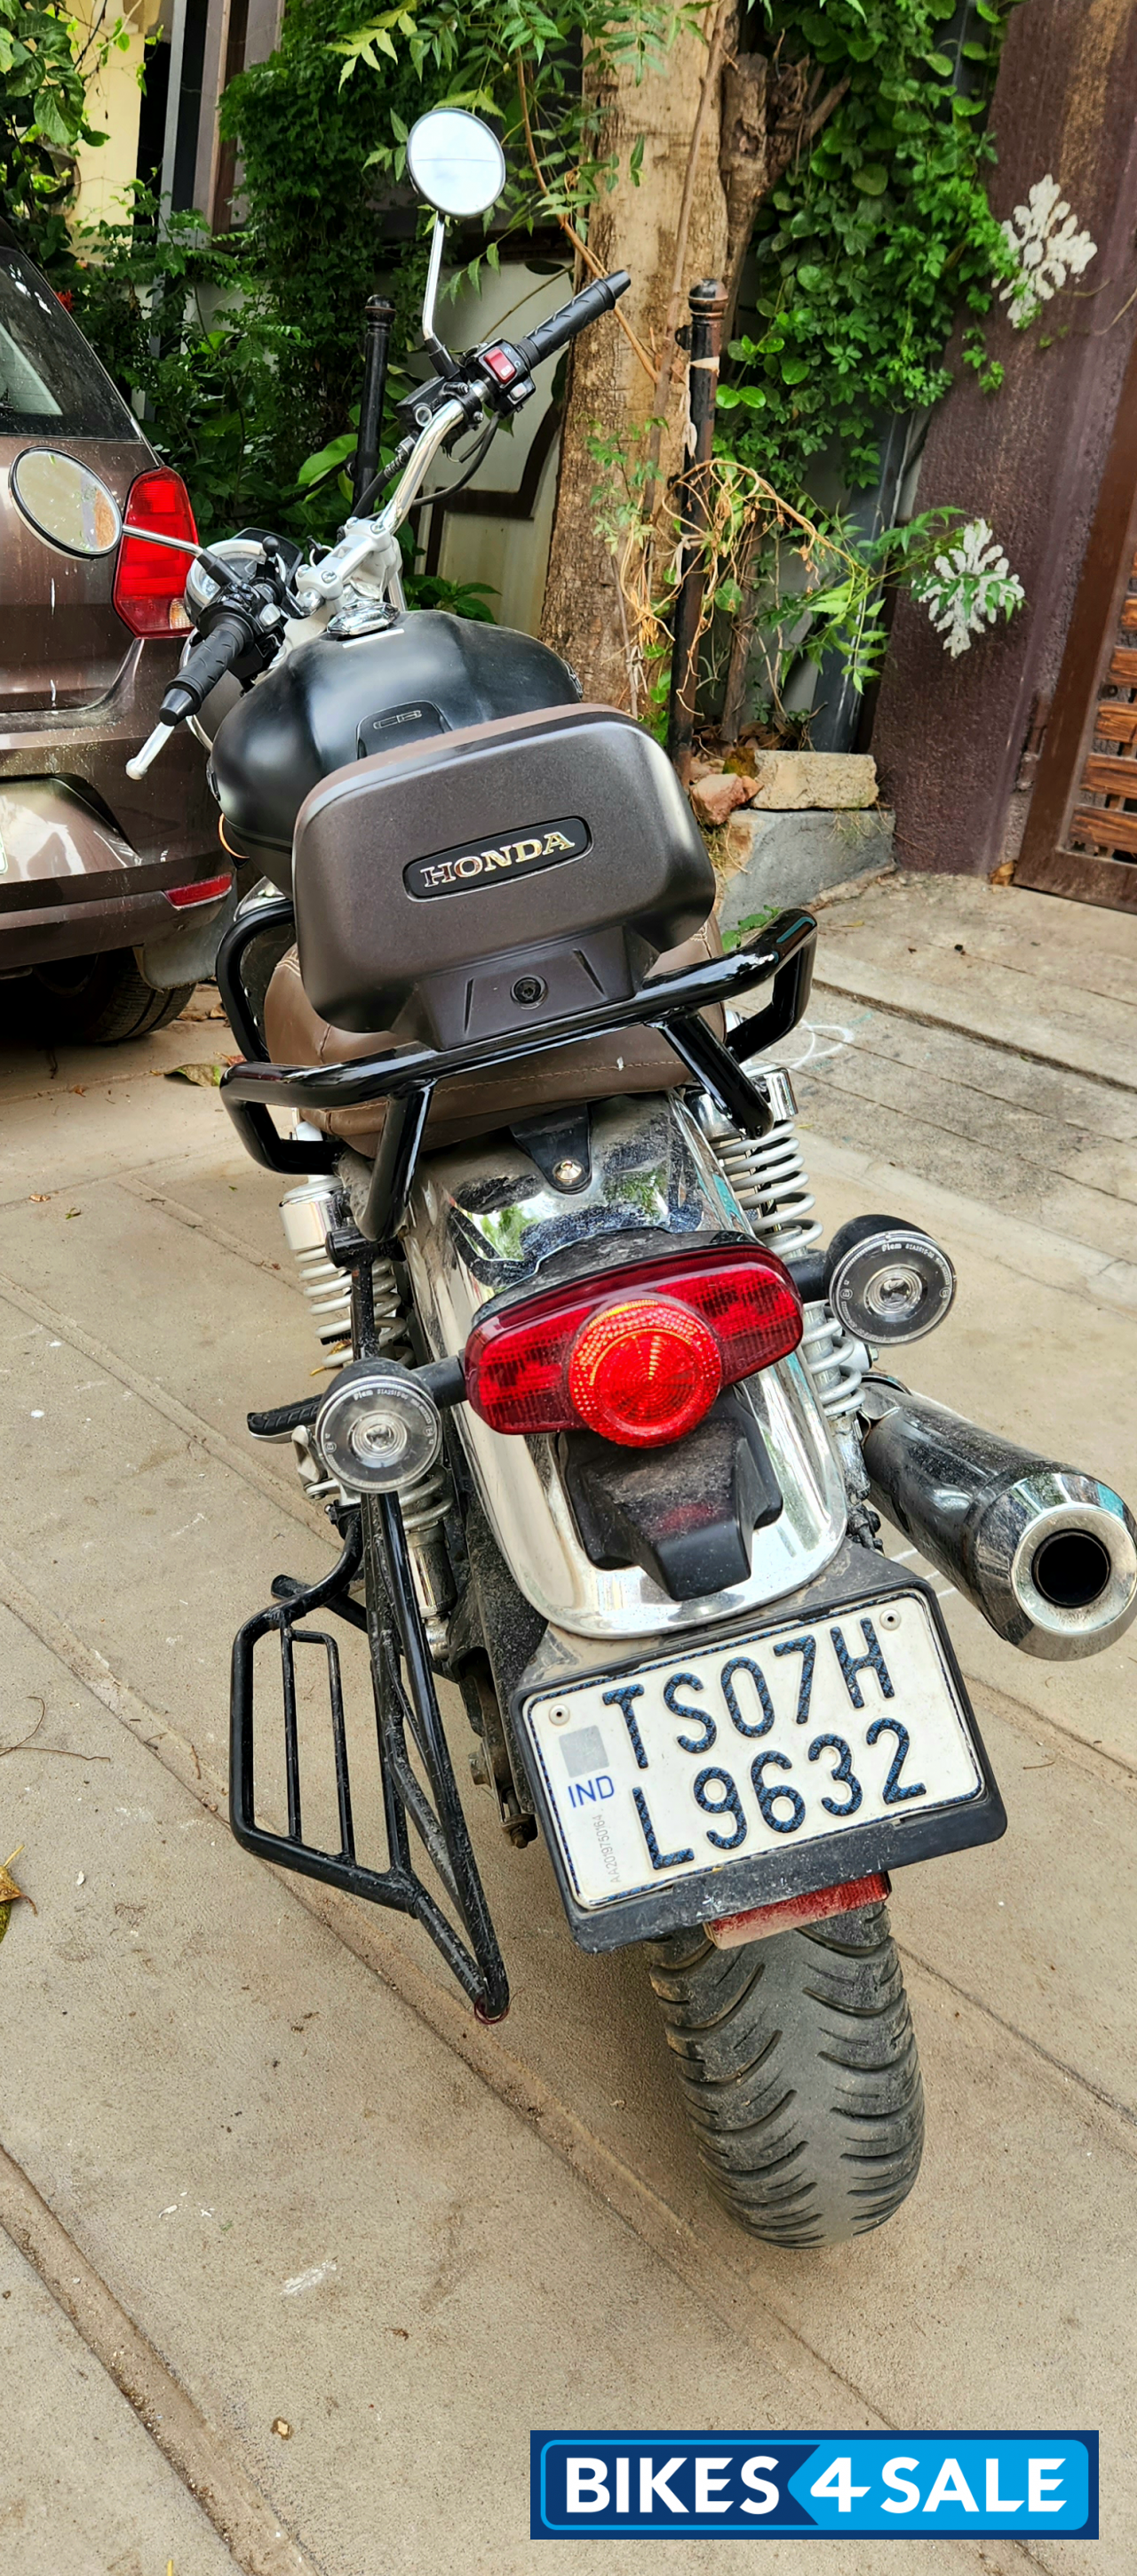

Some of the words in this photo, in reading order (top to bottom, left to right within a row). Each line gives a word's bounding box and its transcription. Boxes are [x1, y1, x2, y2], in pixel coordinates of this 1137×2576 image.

[420, 831, 576, 888] HONDA
[602, 1617, 895, 1769] TS07H
[568, 1774, 615, 1808] IND
[632, 1716, 926, 1870] L9632
